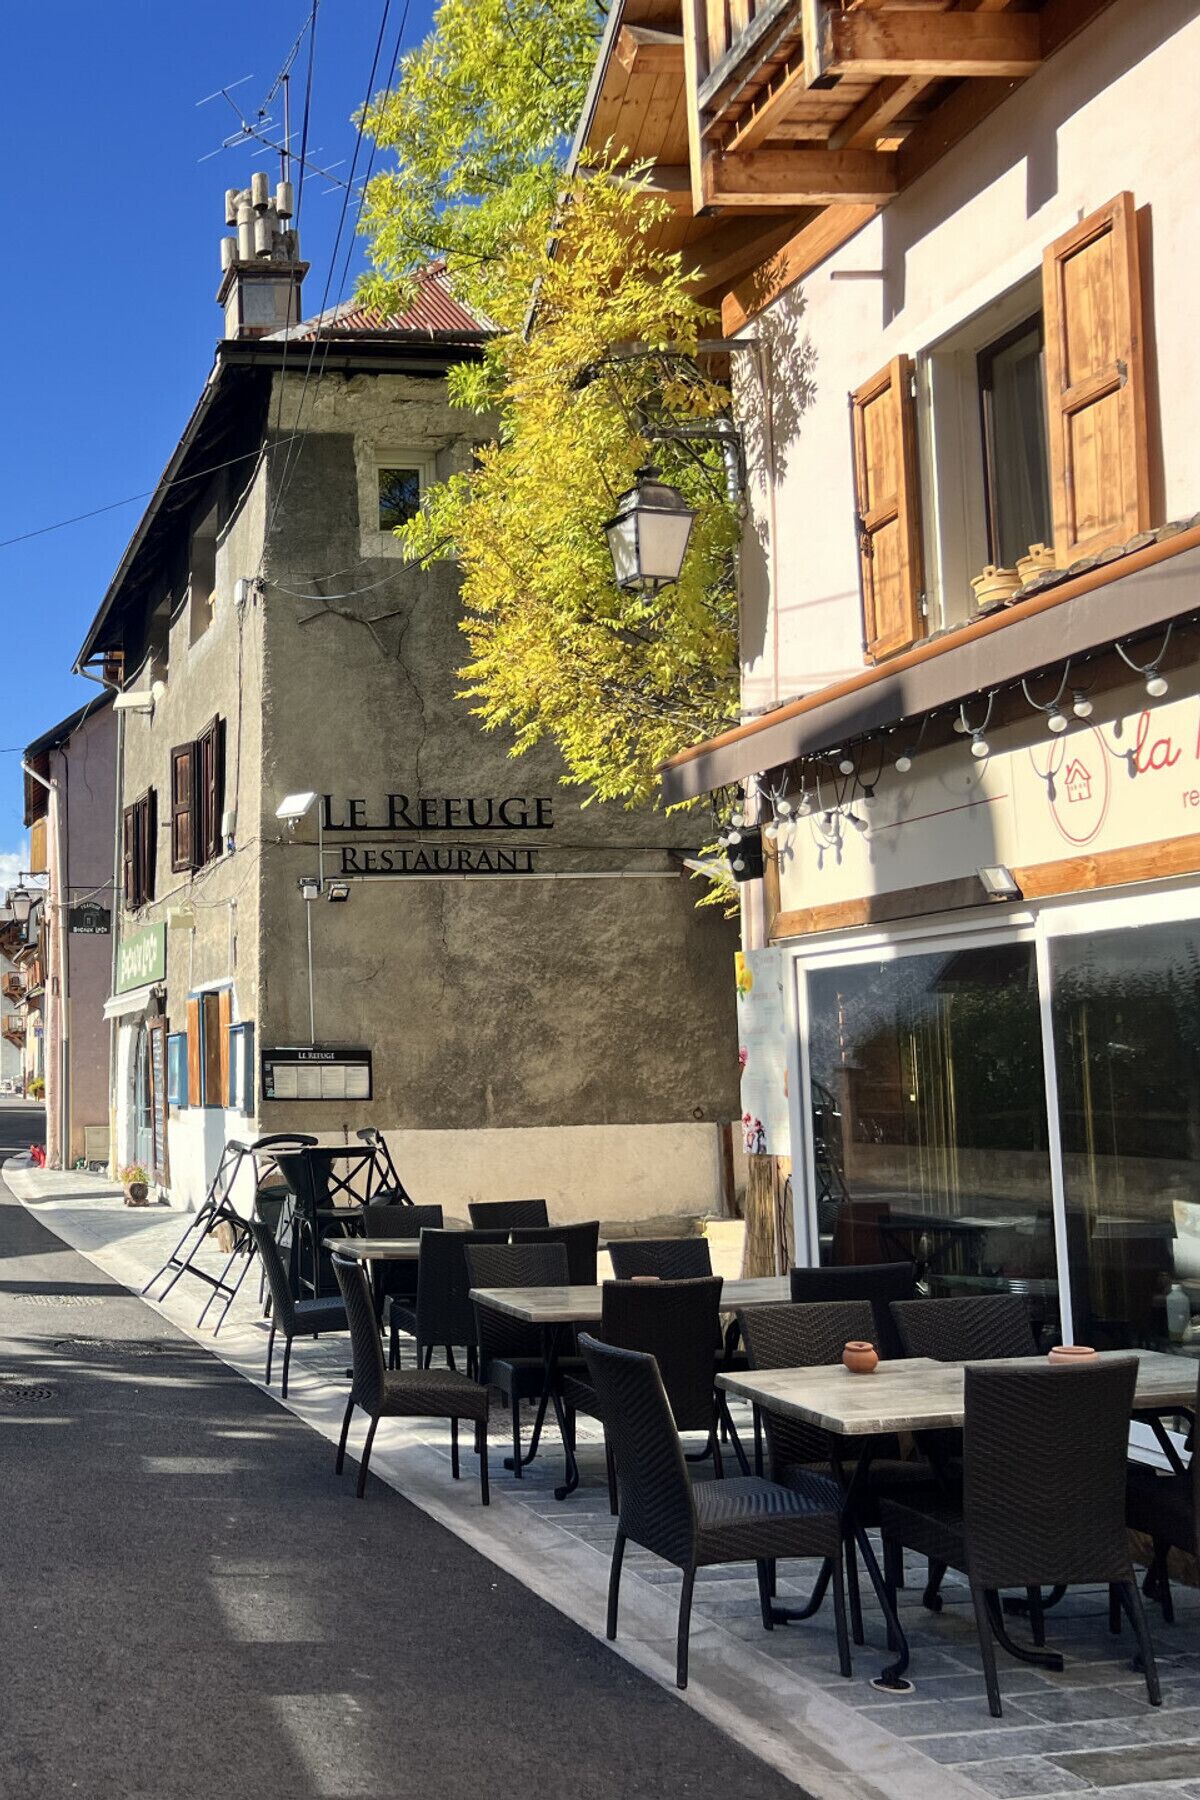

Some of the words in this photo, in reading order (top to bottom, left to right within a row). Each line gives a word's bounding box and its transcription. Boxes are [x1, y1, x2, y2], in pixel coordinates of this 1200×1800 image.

[1134, 708, 1182, 773] la
[322, 794, 367, 829] LE
[385, 793, 554, 829] REFUGE
[341, 847, 538, 873] RESTAURANT
